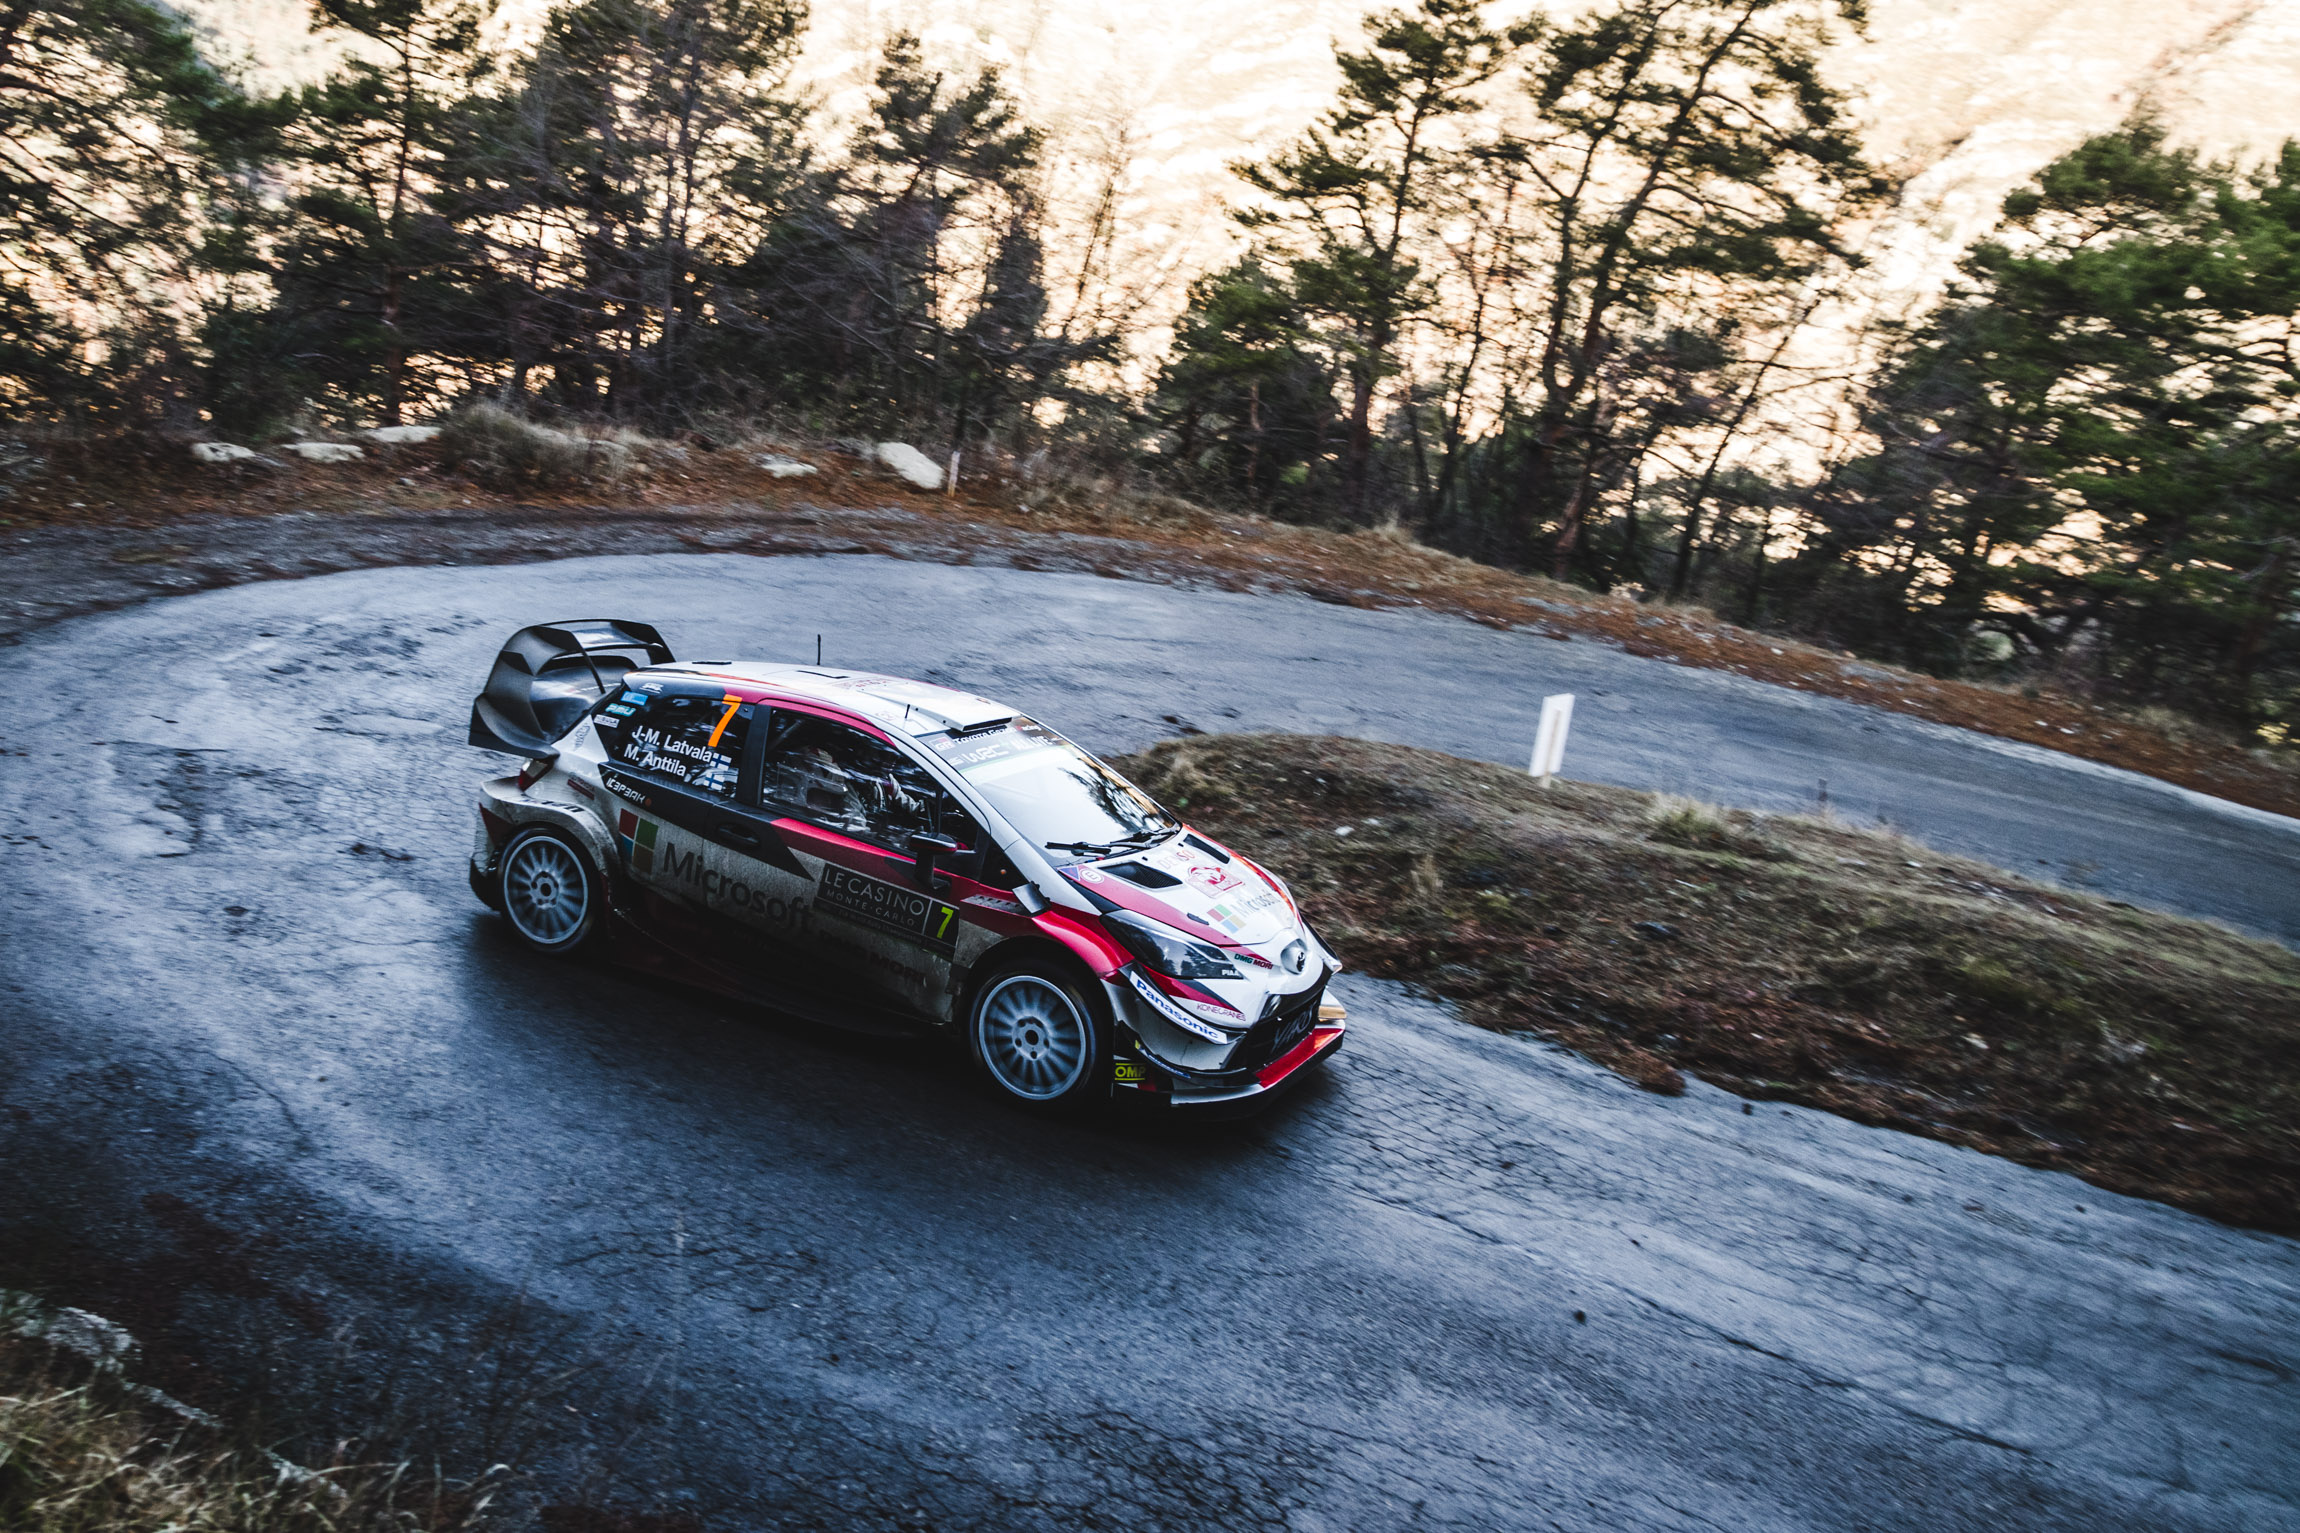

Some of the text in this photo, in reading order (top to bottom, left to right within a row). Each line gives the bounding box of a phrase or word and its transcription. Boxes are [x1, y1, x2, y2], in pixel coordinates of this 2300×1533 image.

[708, 694, 743, 748] 7
[624, 743, 687, 777] M. Anttila
[631, 725, 713, 763] J-M. Latvala
[663, 842, 813, 934] Microsoft
[824, 868, 925, 916] LE CASINO
[936, 906, 954, 939] 7
[1234, 953, 1274, 970] DMG MORI
[1136, 978, 1219, 1040] Panasonic
[1196, 1003, 1247, 1022] KONECRANES
[1115, 1066, 1146, 1078] OMP
